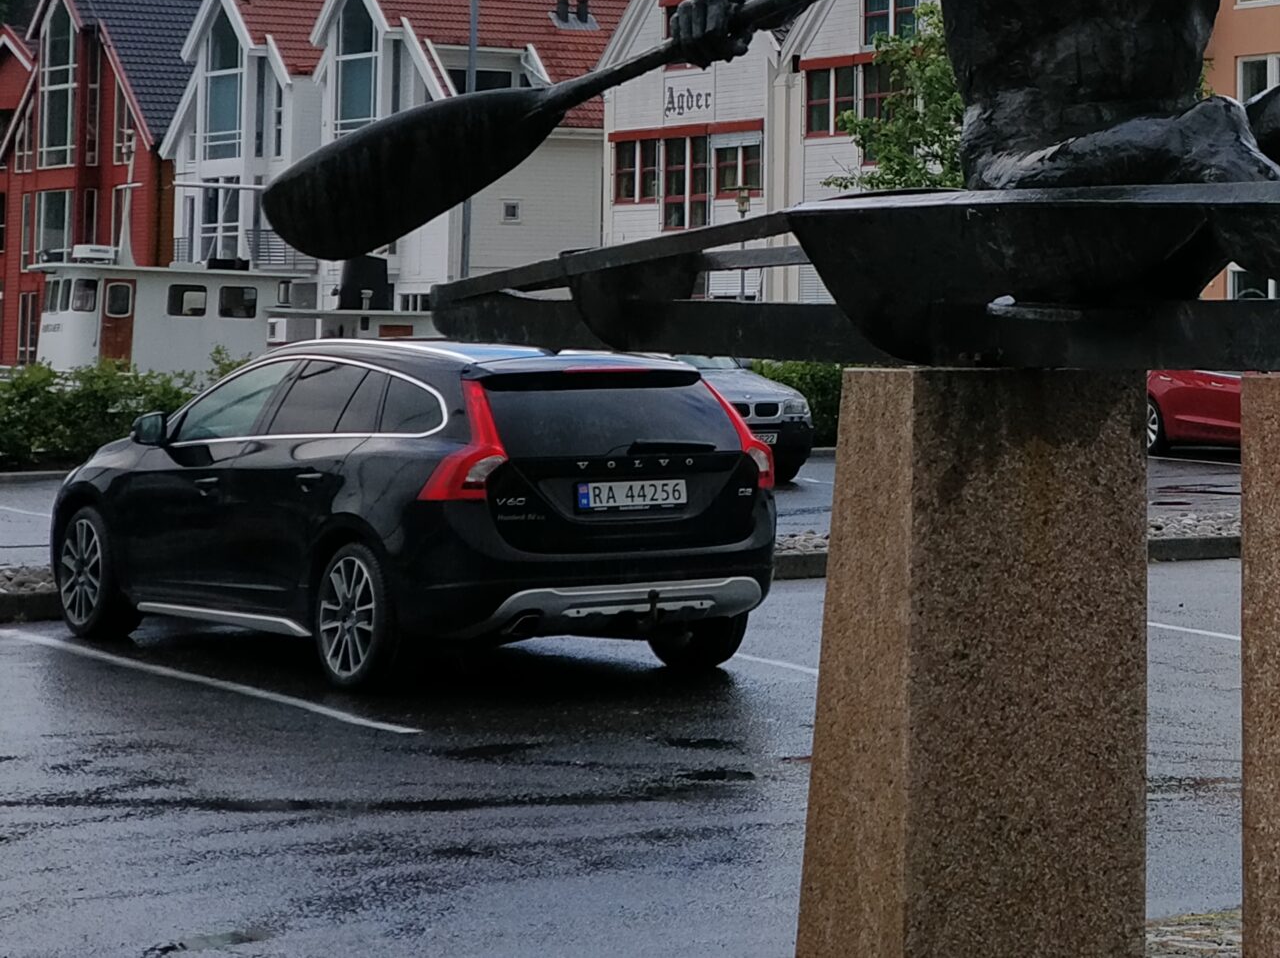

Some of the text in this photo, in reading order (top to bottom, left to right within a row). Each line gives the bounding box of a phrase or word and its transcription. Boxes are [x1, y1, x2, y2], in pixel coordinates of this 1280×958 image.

[664, 86, 712, 118] Agder
[576, 457, 694, 470] VOLVO
[592, 482, 682, 505] RA 44256
